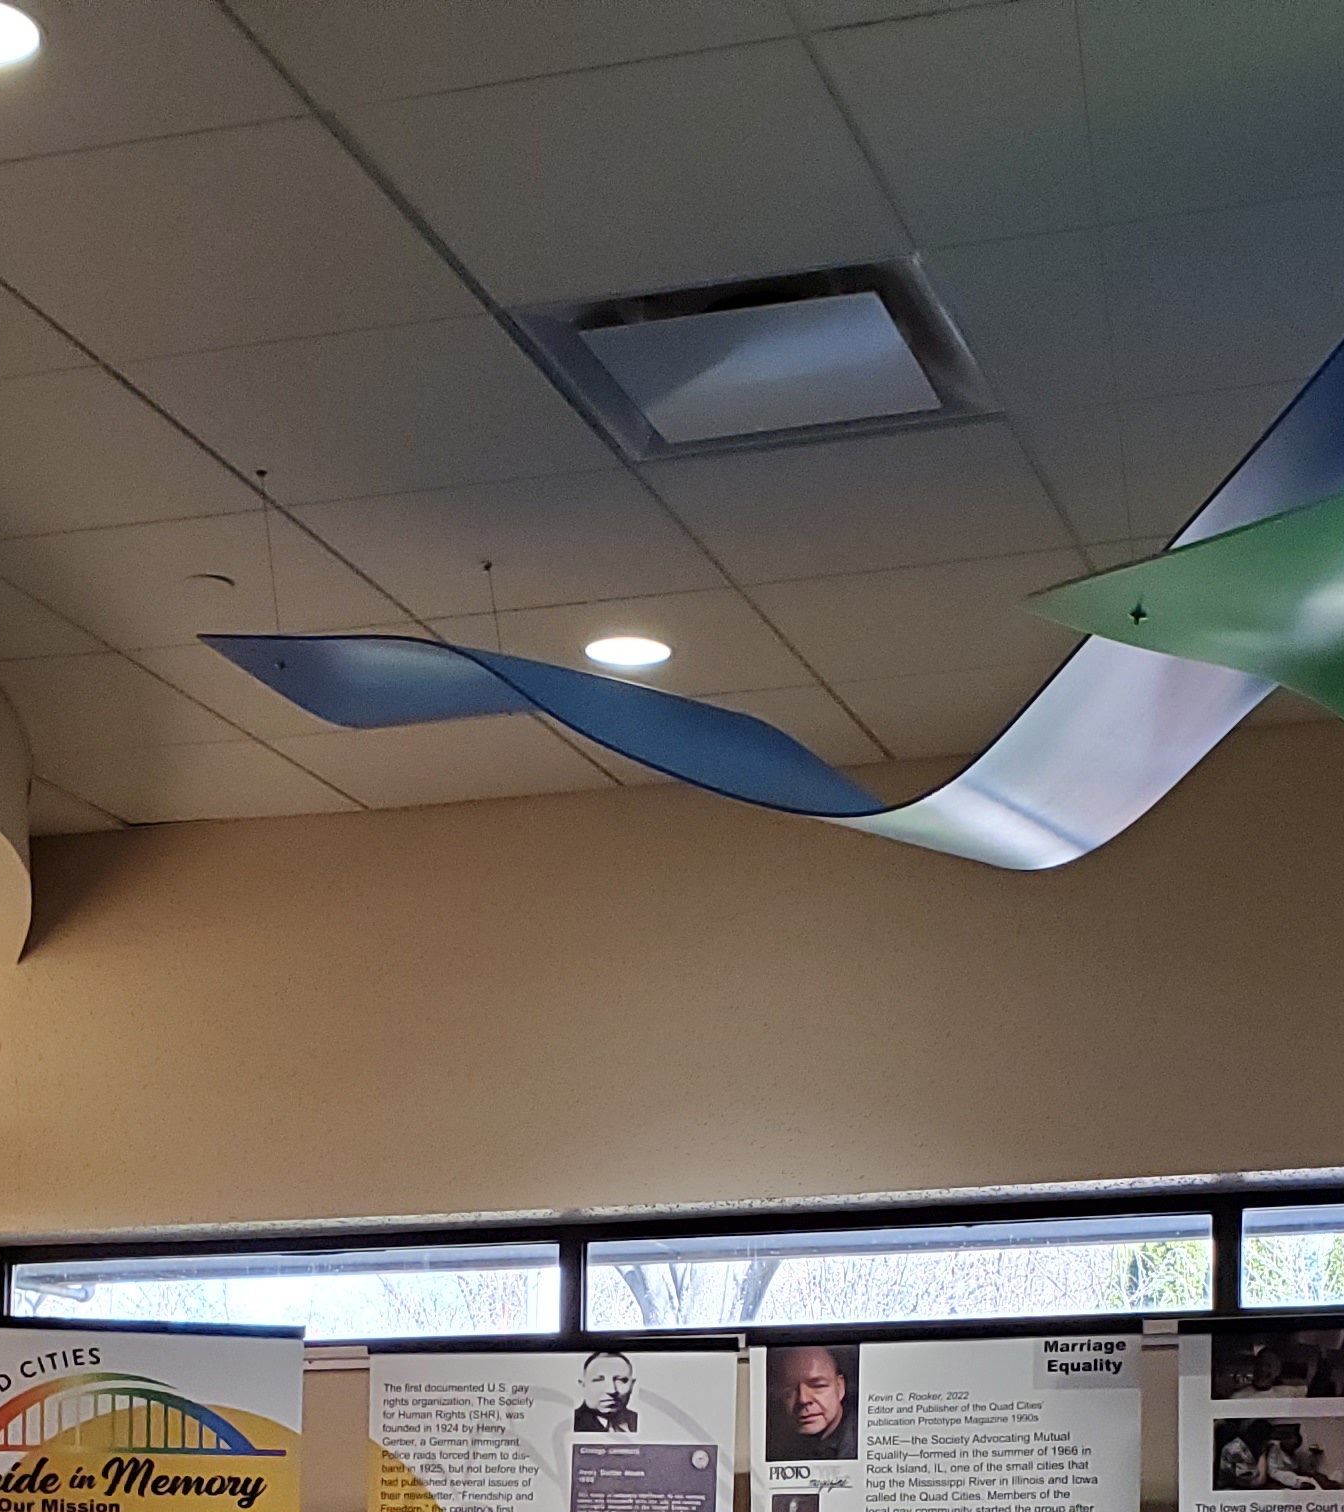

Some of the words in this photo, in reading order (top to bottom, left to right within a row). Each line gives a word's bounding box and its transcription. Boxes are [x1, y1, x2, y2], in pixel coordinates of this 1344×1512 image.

[1044, 1339, 1126, 1355] Marriage
[20, 1348, 101, 1378] CITIES
[1047, 1358, 1123, 1375] Equality
[383, 1382, 402, 1392] The
[404, 1383, 422, 1392] first
[424, 1383, 484, 1392] documented
[511, 1385, 529, 1394] gay
[382, 1423, 420, 1432] founded
[435, 1423, 458, 1432] 1924
[461, 1423, 474, 1434] by
[475, 1423, 506, 1434] Henry
[930, 1433, 970, 1446] Society
[971, 1433, 1030, 1445] Advocating
[1033, 1431, 1070, 1441] Mutual
[69, 1467, 96, 1489] in
[102, 1456, 267, 1508] Memory
[865, 1477, 886, 1490] hug
[888, 1478, 905, 1488] the
[908, 1476, 965, 1489] Mississippi
[968, 1476, 996, 1486] River
[998, 1477, 1008, 1485] in
[1011, 1475, 1044, 1485] Illinois
[1047, 1474, 1068, 1484] and
[1071, 1474, 1098, 1484] Iowa
[41, 1498, 120, 1512] Mission
[1194, 1503, 1216, 1512] The
[1219, 1503, 1246, 1512] Iowa
[1249, 1502, 1302, 1512] Supreme
[1305, 1501, 1338, 1512] Court
